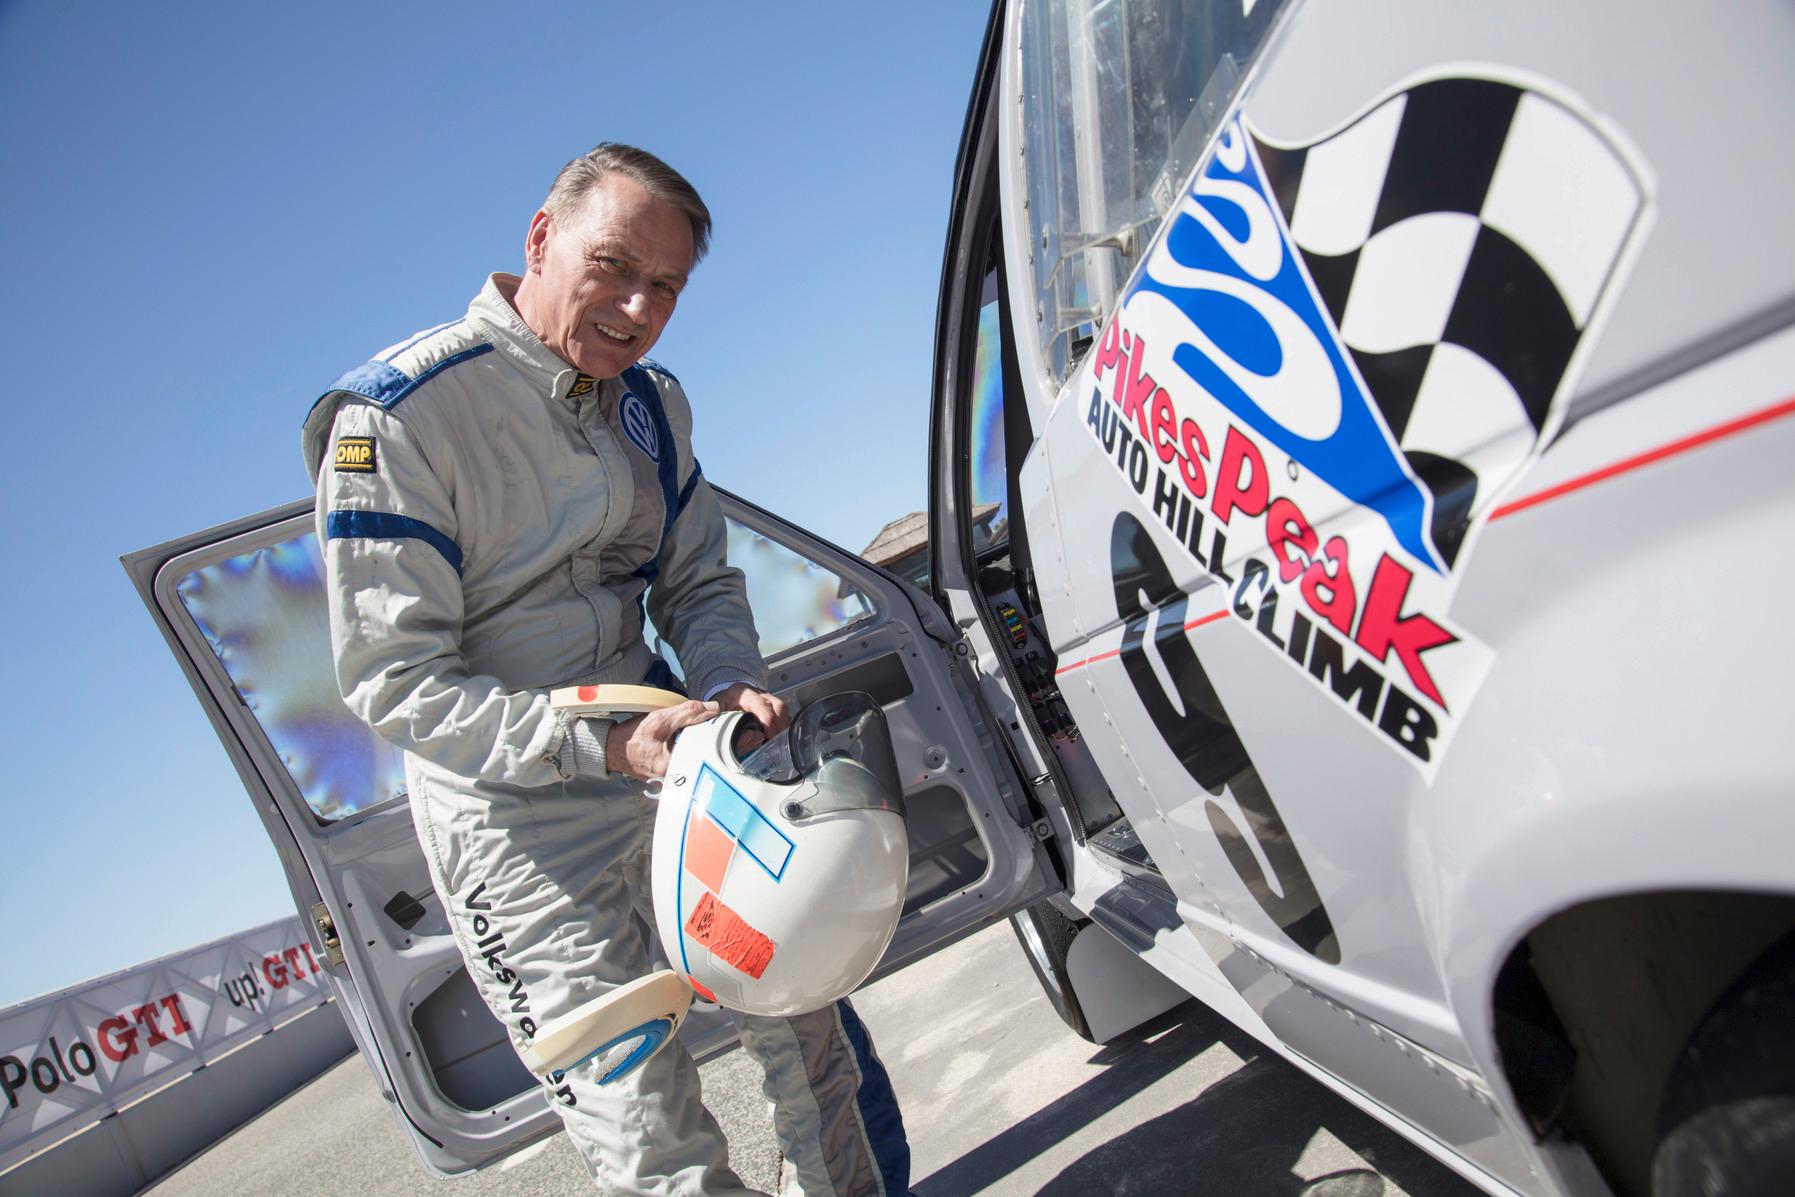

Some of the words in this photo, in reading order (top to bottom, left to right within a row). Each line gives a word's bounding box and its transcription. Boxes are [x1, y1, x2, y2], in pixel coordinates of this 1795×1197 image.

[336, 445, 371, 463] OMP
[1087, 385, 1149, 495] AUTO
[1153, 466, 1235, 590] HILL
[1233, 558, 1439, 764] CLIMB
[1211, 424, 1462, 717] Peak
[262, 943, 320, 989] GTI
[0, 1037, 97, 1109] Polo
[98, 993, 192, 1063] GTI
